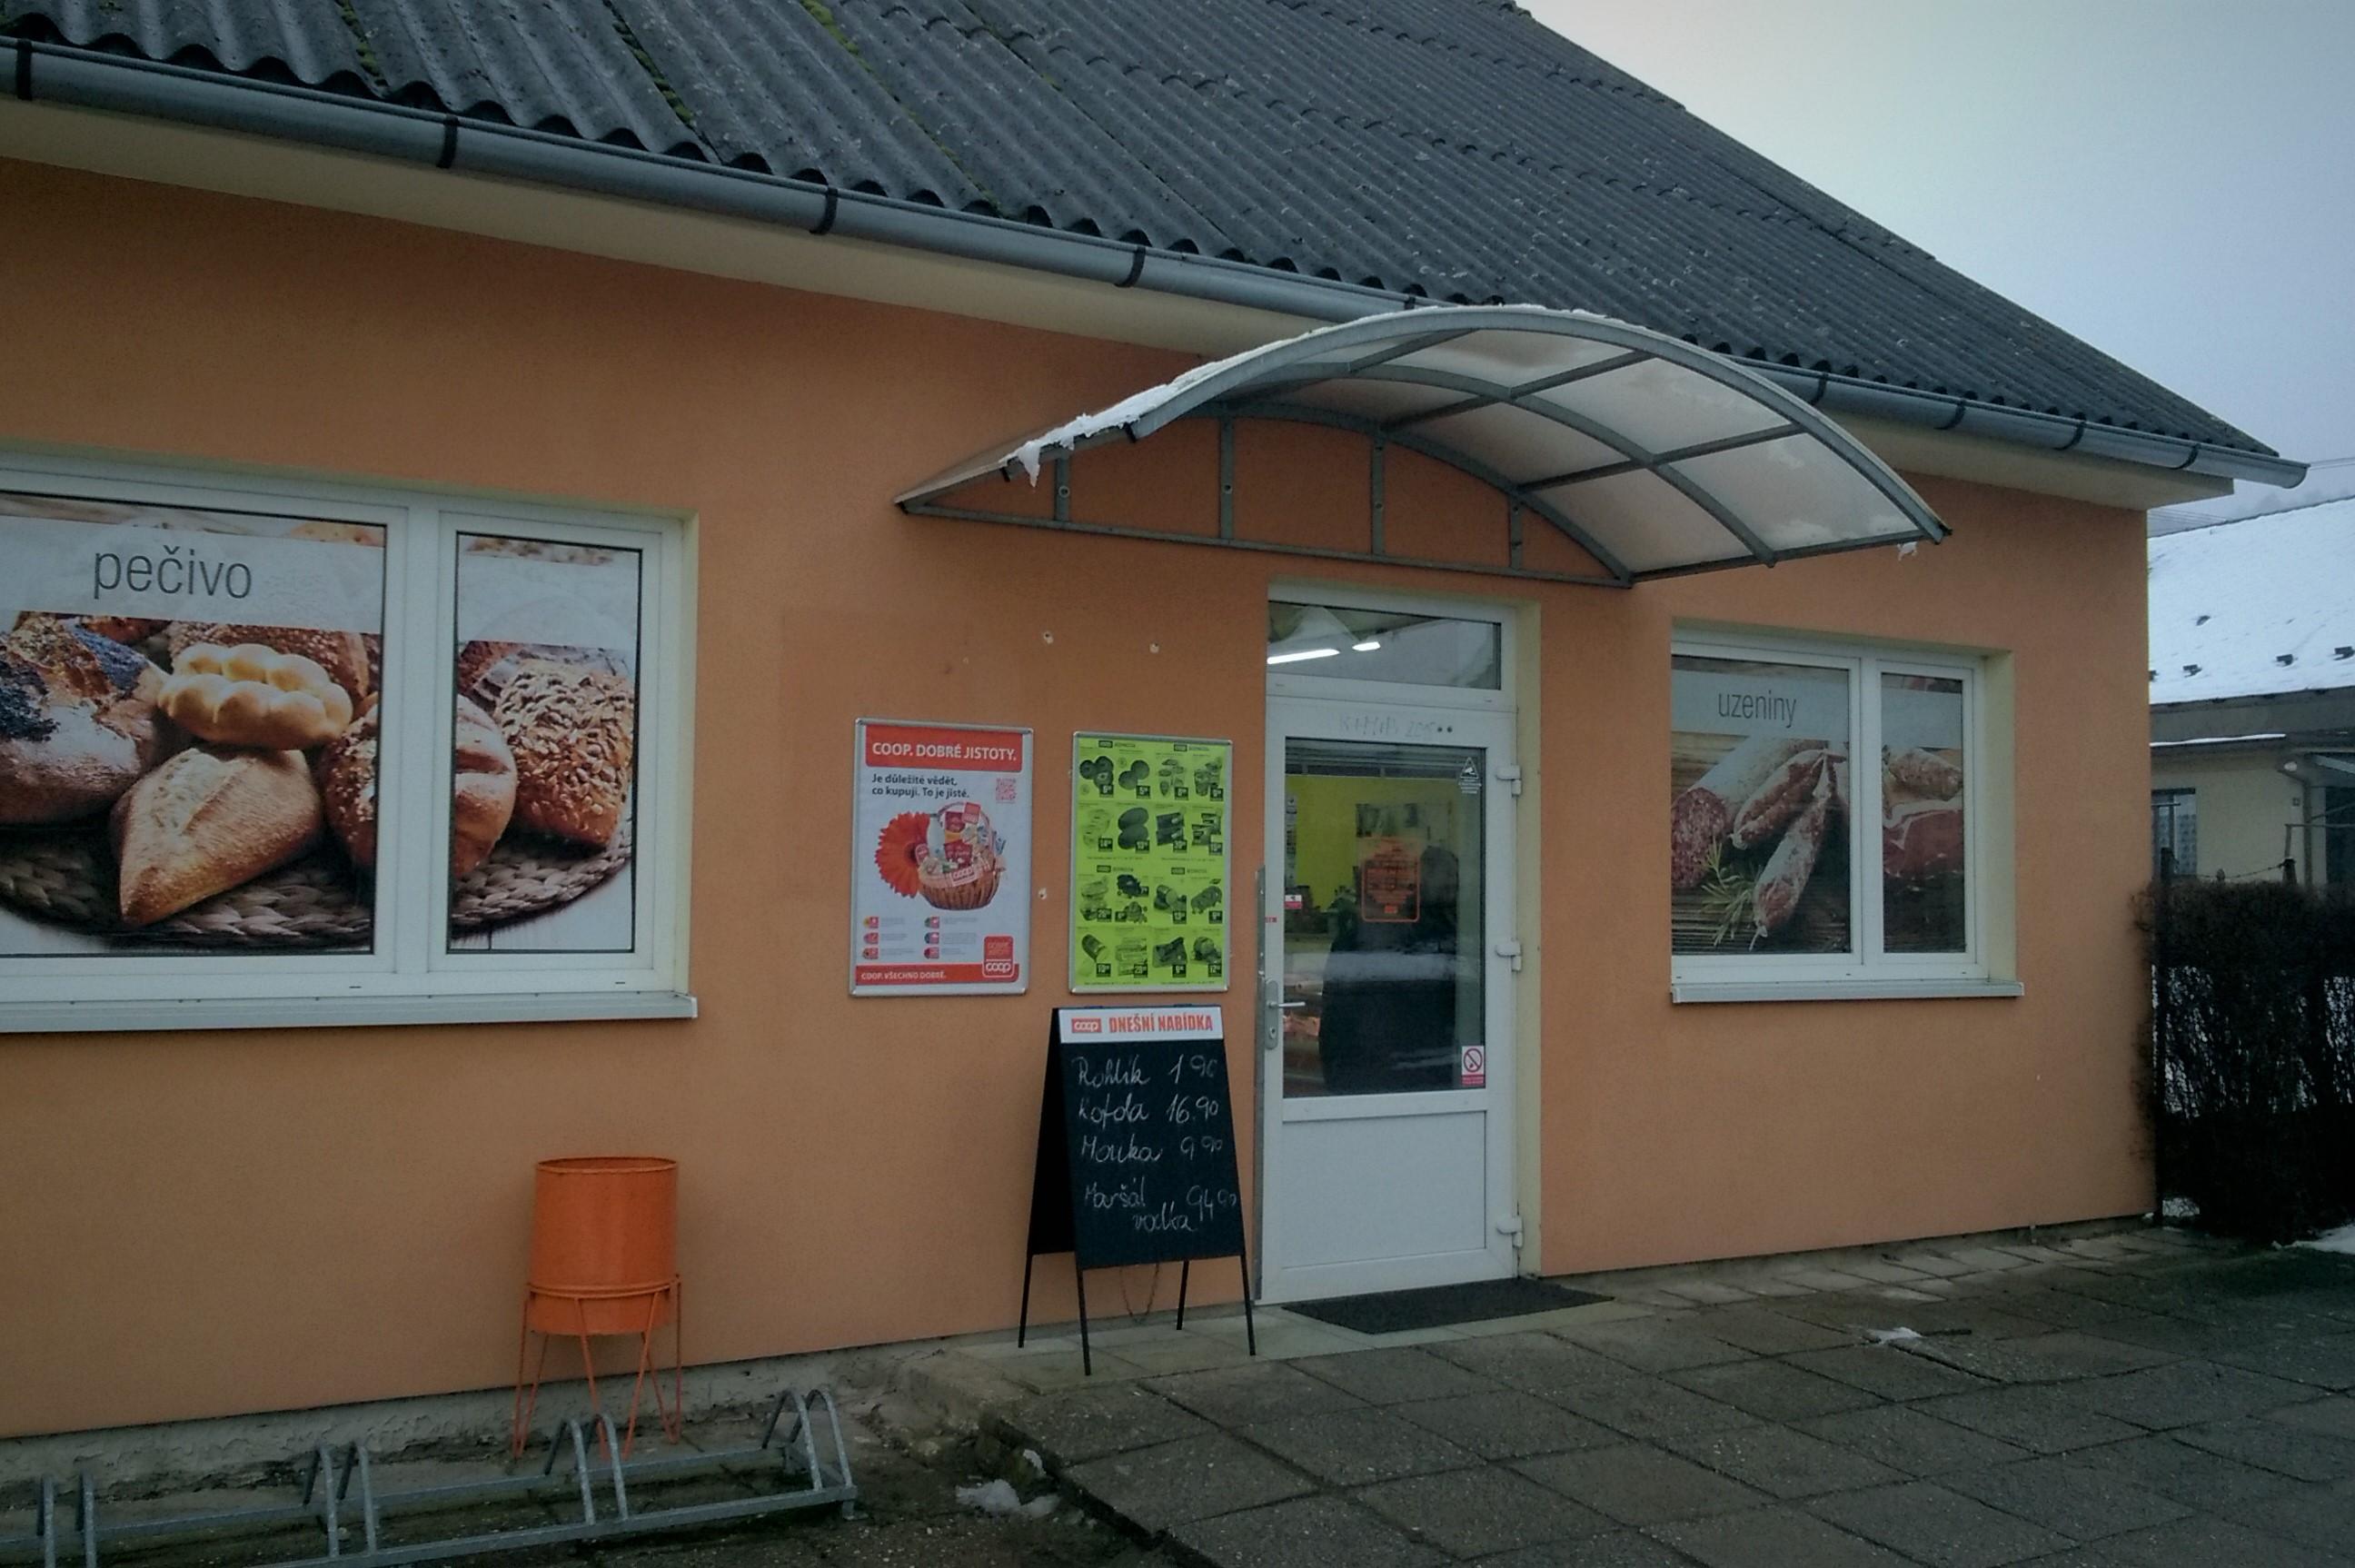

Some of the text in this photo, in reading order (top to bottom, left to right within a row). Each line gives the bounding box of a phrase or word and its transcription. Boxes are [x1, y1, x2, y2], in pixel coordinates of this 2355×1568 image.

[94, 544, 252, 600] pečivo
[1718, 690, 1796, 729] uzeniny
[872, 741, 1017, 761] COOP. DOBRÉ JISTOTY.
[871, 773, 958, 787] Je důležité vědět,
[871, 787, 884, 795] co
[922, 787, 934, 797] To
[935, 789, 945, 799] je
[946, 789, 970, 800] jisté.
[1108, 1013, 1155, 1033] DNEŠNÍ
[1158, 1012, 1214, 1032] NABÍDKA
[1071, 1054, 1151, 1088] Rohlík
[1081, 1133, 1163, 1164] Mouka
